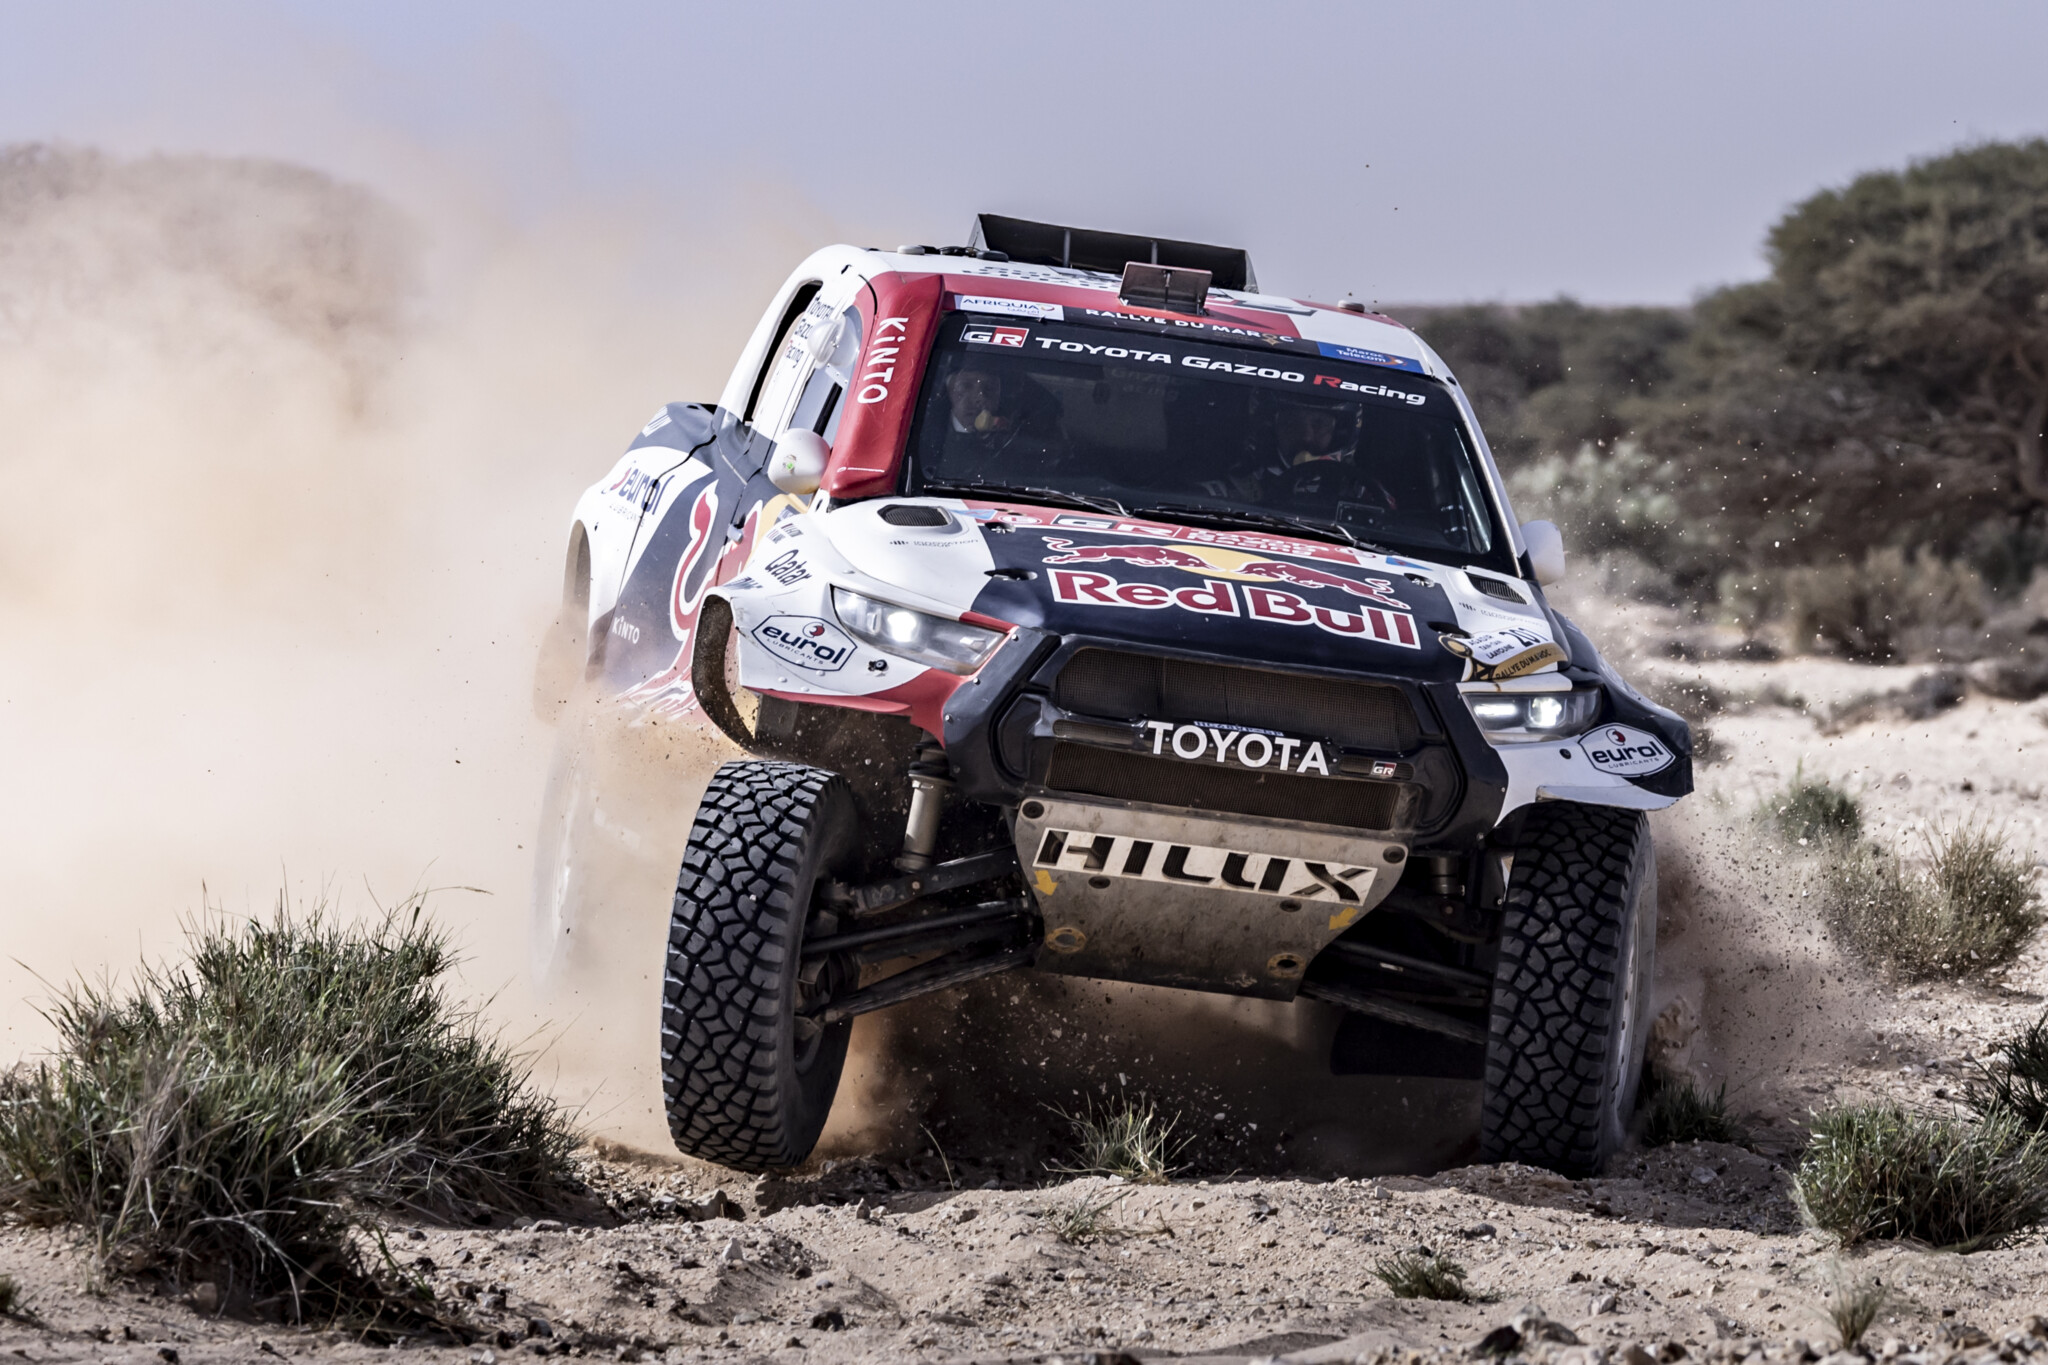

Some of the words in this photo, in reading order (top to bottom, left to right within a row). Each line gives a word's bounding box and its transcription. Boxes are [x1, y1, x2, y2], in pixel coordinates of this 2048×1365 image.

[963, 298, 1040, 311] AFRIQUIA
[964, 328, 1025, 348] GR
[1086, 308, 1167, 325] RALLYE
[1174, 320, 1204, 329] DU
[1212, 325, 1295, 344] MAROC
[1336, 349, 1386, 363] Telecom
[1346, 347, 1384, 359] Maroc
[1035, 336, 1172, 366] TOYOTA
[1181, 355, 1305, 384] GAZOO
[1313, 373, 1426, 407] Racing
[618, 468, 675, 515] eurol
[1056, 516, 1175, 538] GR
[764, 549, 813, 586] Qatar
[1047, 569, 1240, 617] Red
[1242, 584, 1421, 650] Bull
[762, 625, 847, 665] eurol
[1499, 627, 1549, 648] 201
[767, 637, 824, 665] LUBRICANTS
[1496, 664, 1521, 681] RALLYE
[1519, 658, 1530, 669] DU
[1147, 720, 1329, 777] TOYOTA
[1591, 740, 1665, 764] eurol
[1371, 765, 1395, 777] GR
[1608, 757, 1661, 769] LUBRICANTS
[1037, 830, 1370, 903] HILUX
